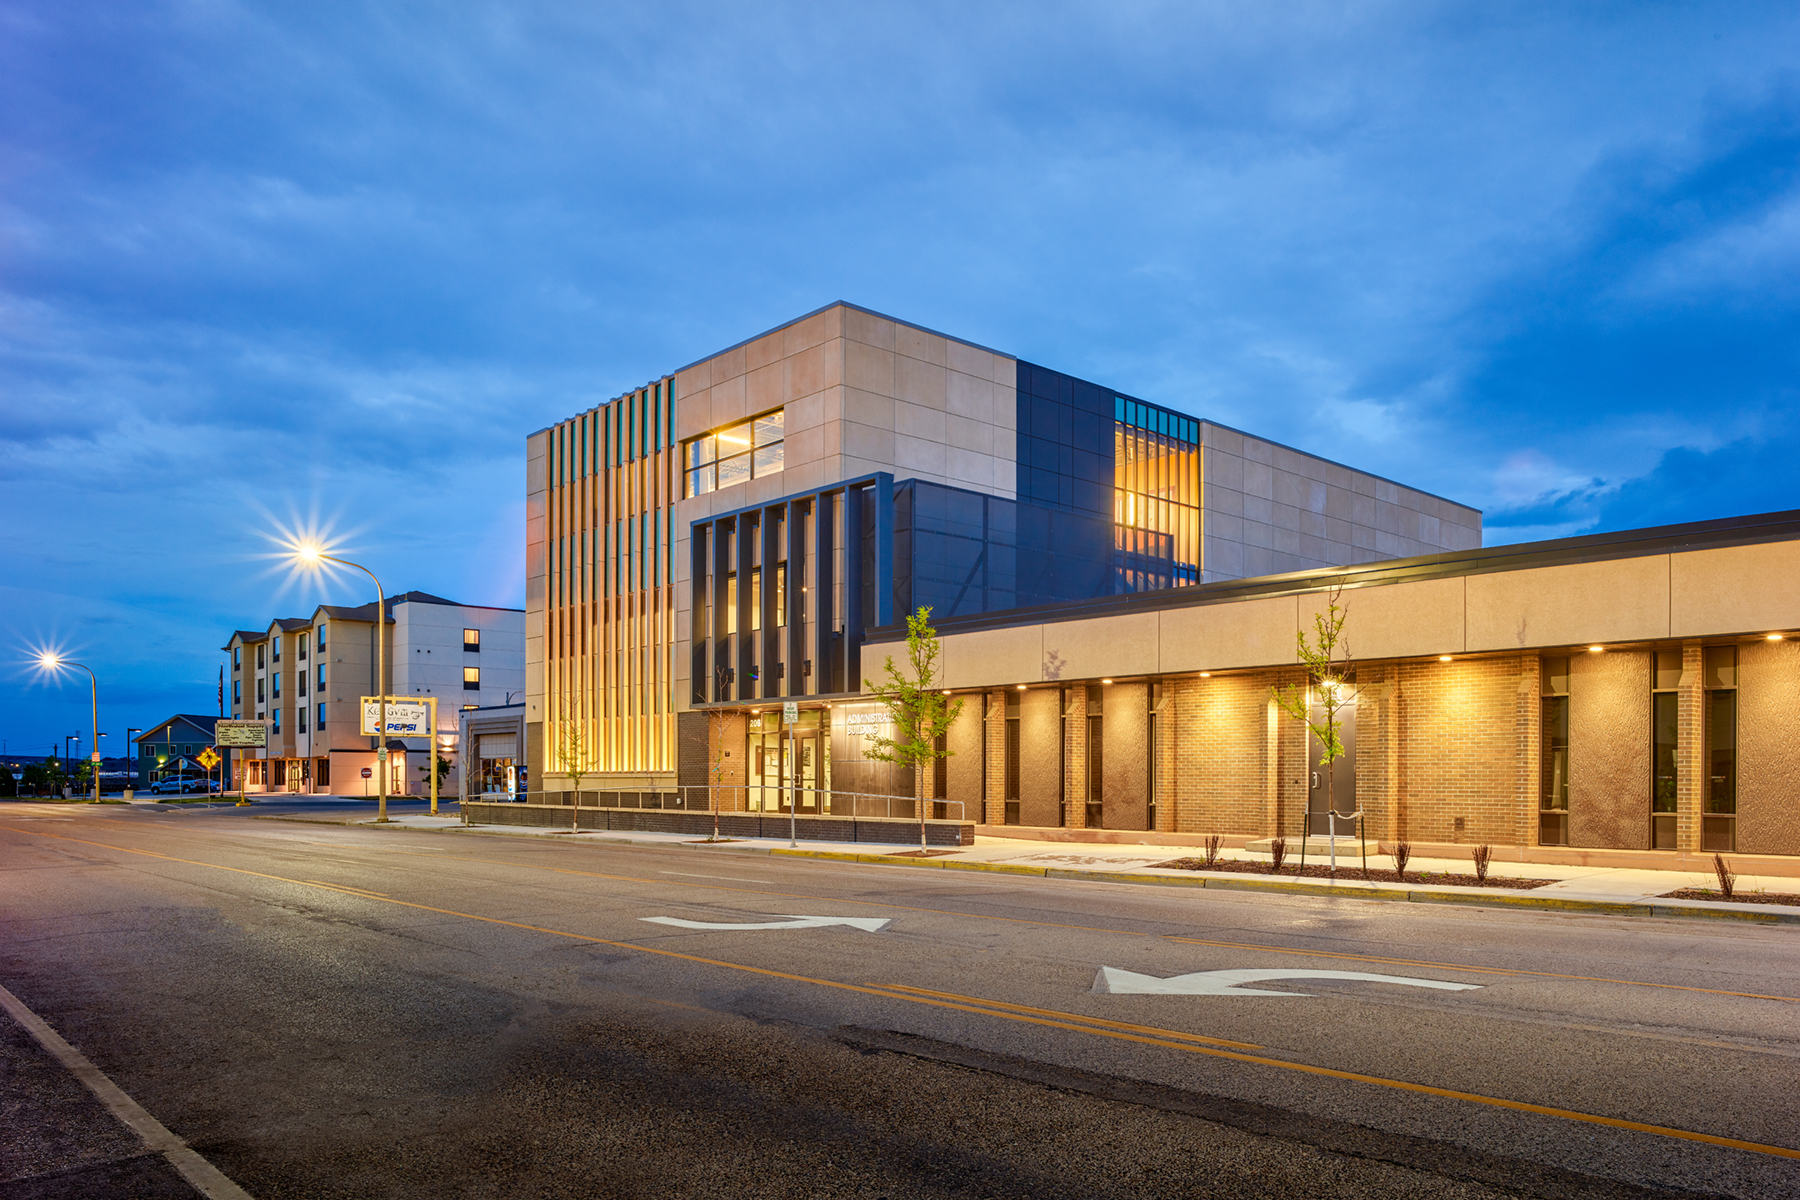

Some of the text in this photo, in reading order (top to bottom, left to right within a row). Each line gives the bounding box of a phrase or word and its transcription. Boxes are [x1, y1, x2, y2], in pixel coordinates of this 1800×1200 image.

[367, 706, 381, 716] Ke
[749, 718, 761, 728] 206
[847, 724, 879, 735] BUILDING
